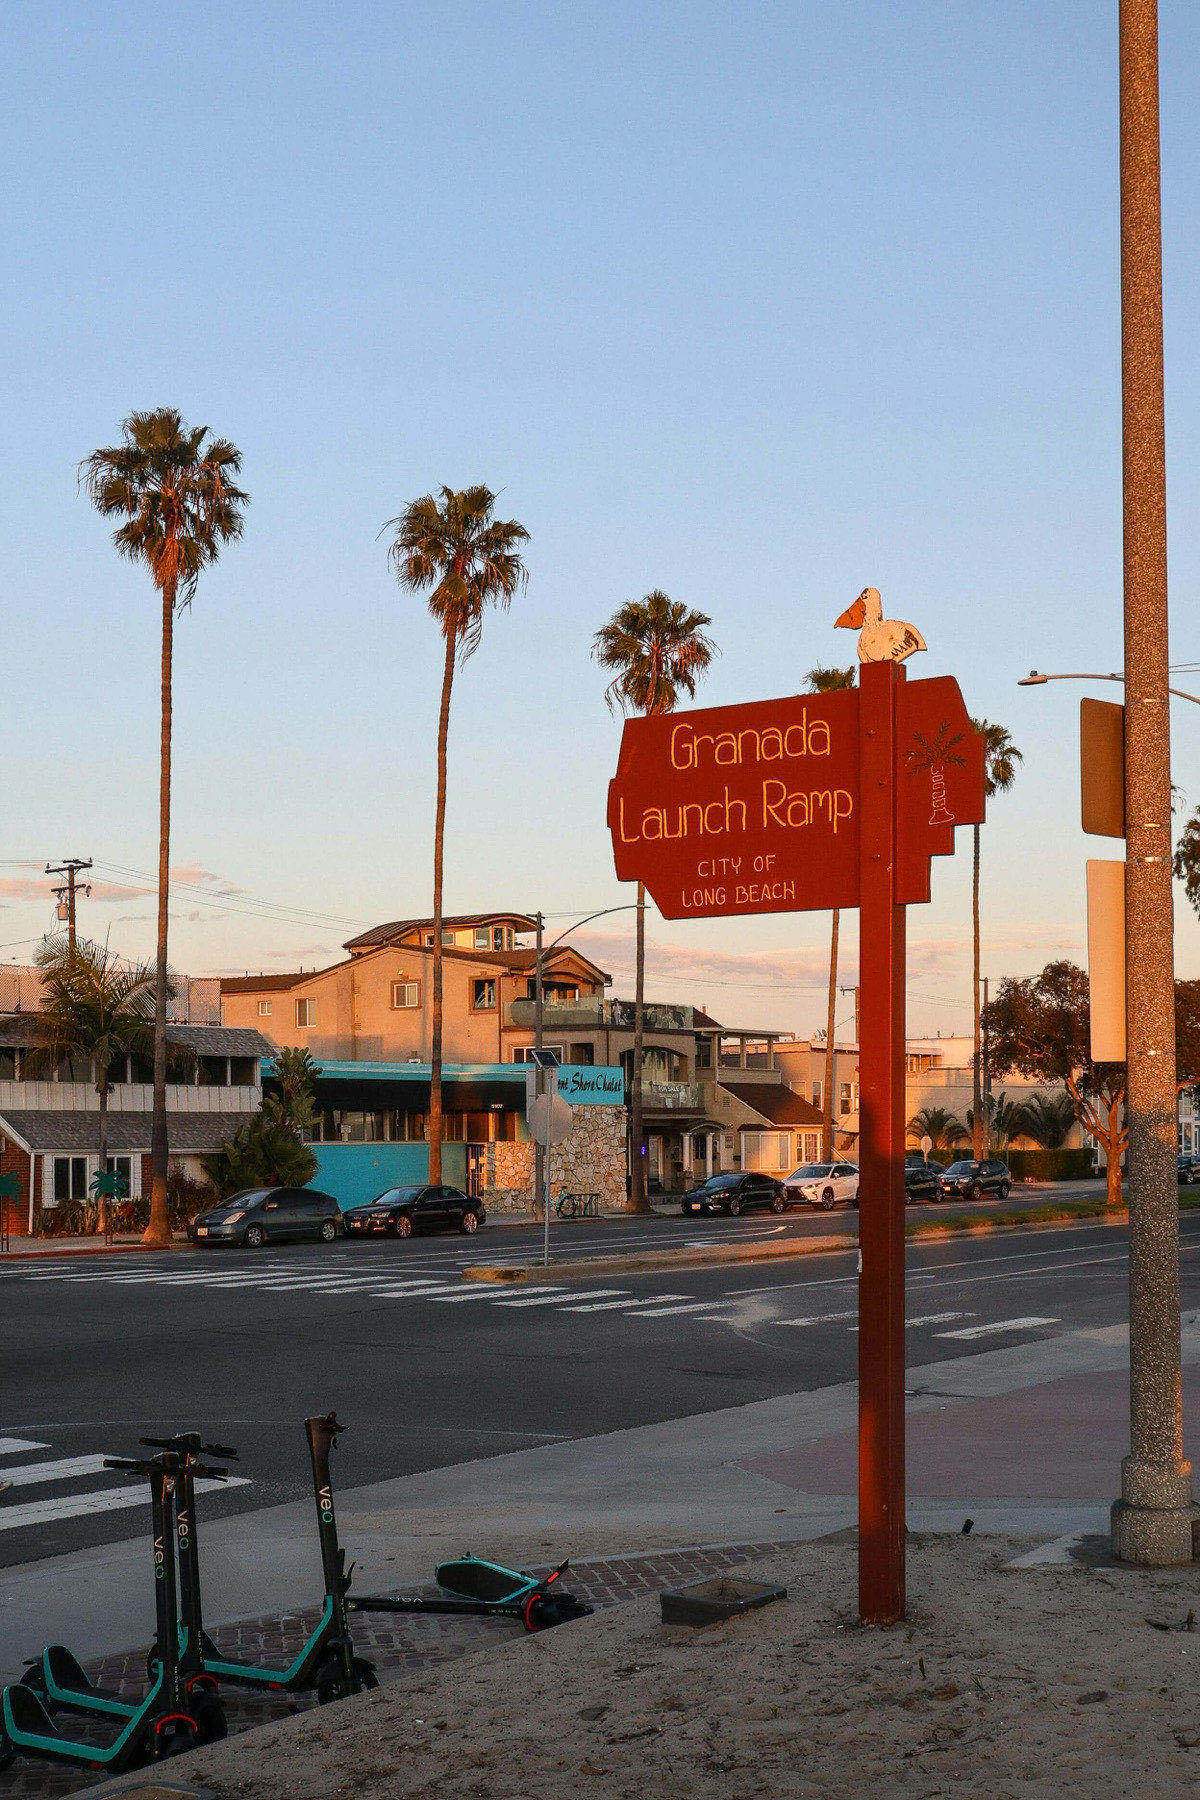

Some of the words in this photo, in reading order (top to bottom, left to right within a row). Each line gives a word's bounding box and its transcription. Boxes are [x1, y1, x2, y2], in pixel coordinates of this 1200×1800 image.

[670, 707, 831, 770] Granada
[619, 786, 747, 843] Launch
[763, 779, 853, 833] Ramp
[697, 858, 742, 877] CITY
[753, 854, 777, 872] OF
[681, 886, 726, 909] LONG
[735, 880, 796, 904] BEACH
[318, 1485, 333, 1524] veo
[177, 1510, 190, 1551] veo
[153, 1536, 166, 1580] veo
